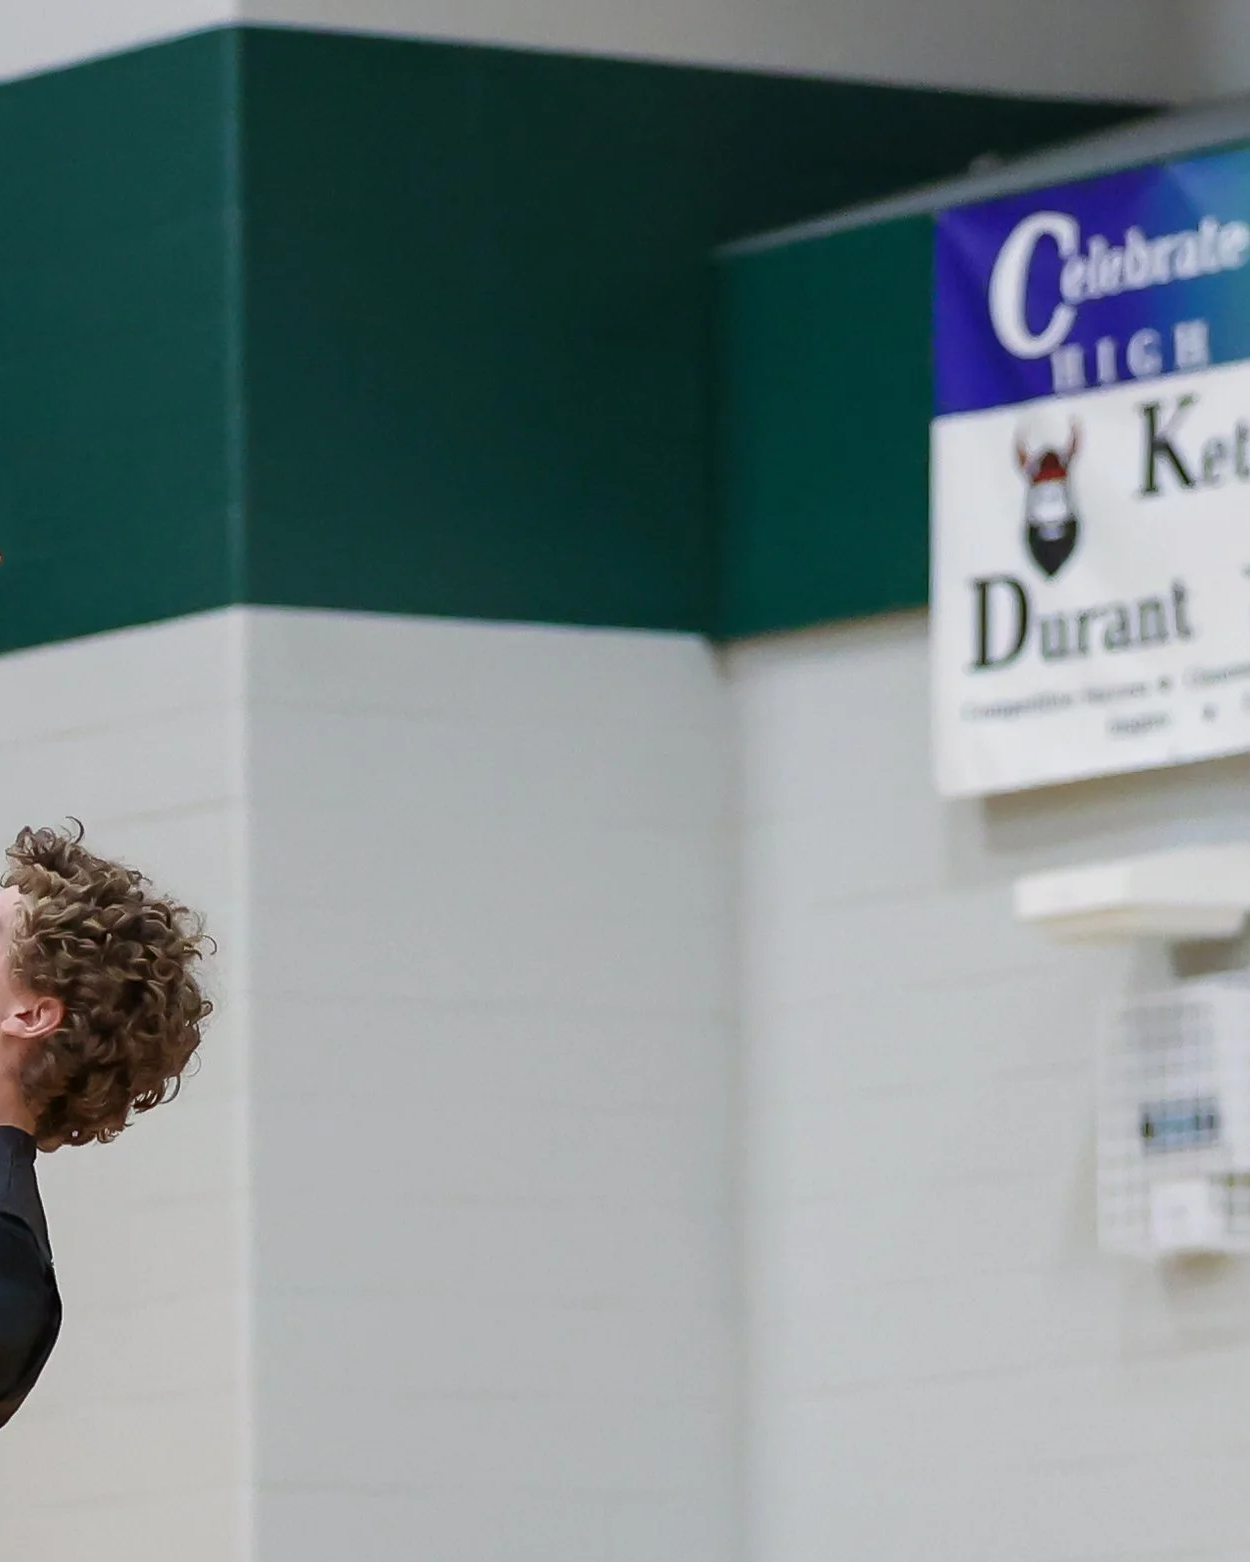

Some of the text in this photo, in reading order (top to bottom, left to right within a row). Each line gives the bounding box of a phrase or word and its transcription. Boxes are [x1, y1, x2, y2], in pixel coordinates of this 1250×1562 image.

[989, 211, 1250, 358] Celebrate
[1051, 319, 1210, 393] HIGH
[965, 574, 1194, 671] Durant
